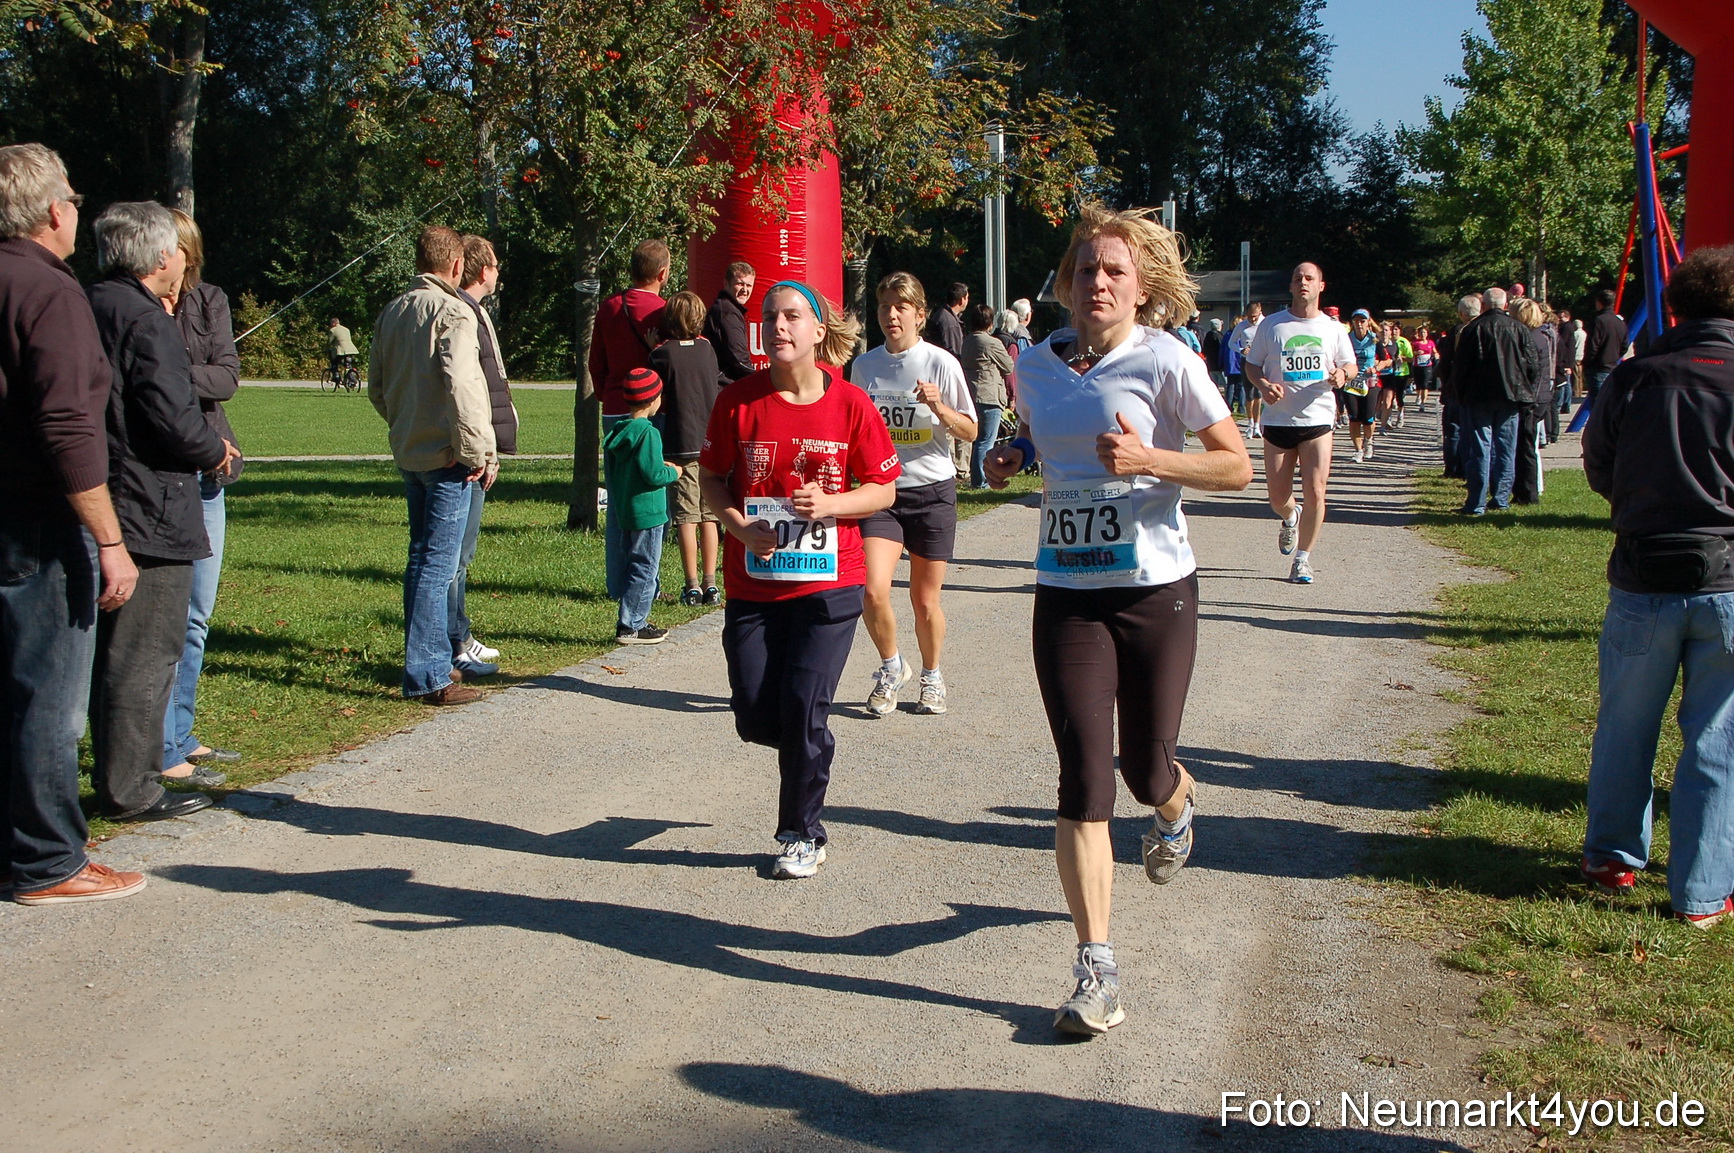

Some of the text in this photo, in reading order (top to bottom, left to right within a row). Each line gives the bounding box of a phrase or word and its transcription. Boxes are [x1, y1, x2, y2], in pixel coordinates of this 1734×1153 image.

[779, 229, 789, 266] Seit 1929
[1286, 356, 1321, 371] 3003
[1297, 372, 1311, 380] Jan
[889, 430, 920, 441] audia
[800, 445, 838, 455] STADTLAUF
[802, 438, 849, 450] NEUMARKTER
[758, 504, 794, 512] PFLEIDERE
[1046, 505, 1121, 545] 2673
[758, 519, 827, 550] 079
[754, 552, 827, 570] Katharina
[1066, 566, 1108, 577] CHRISTA
